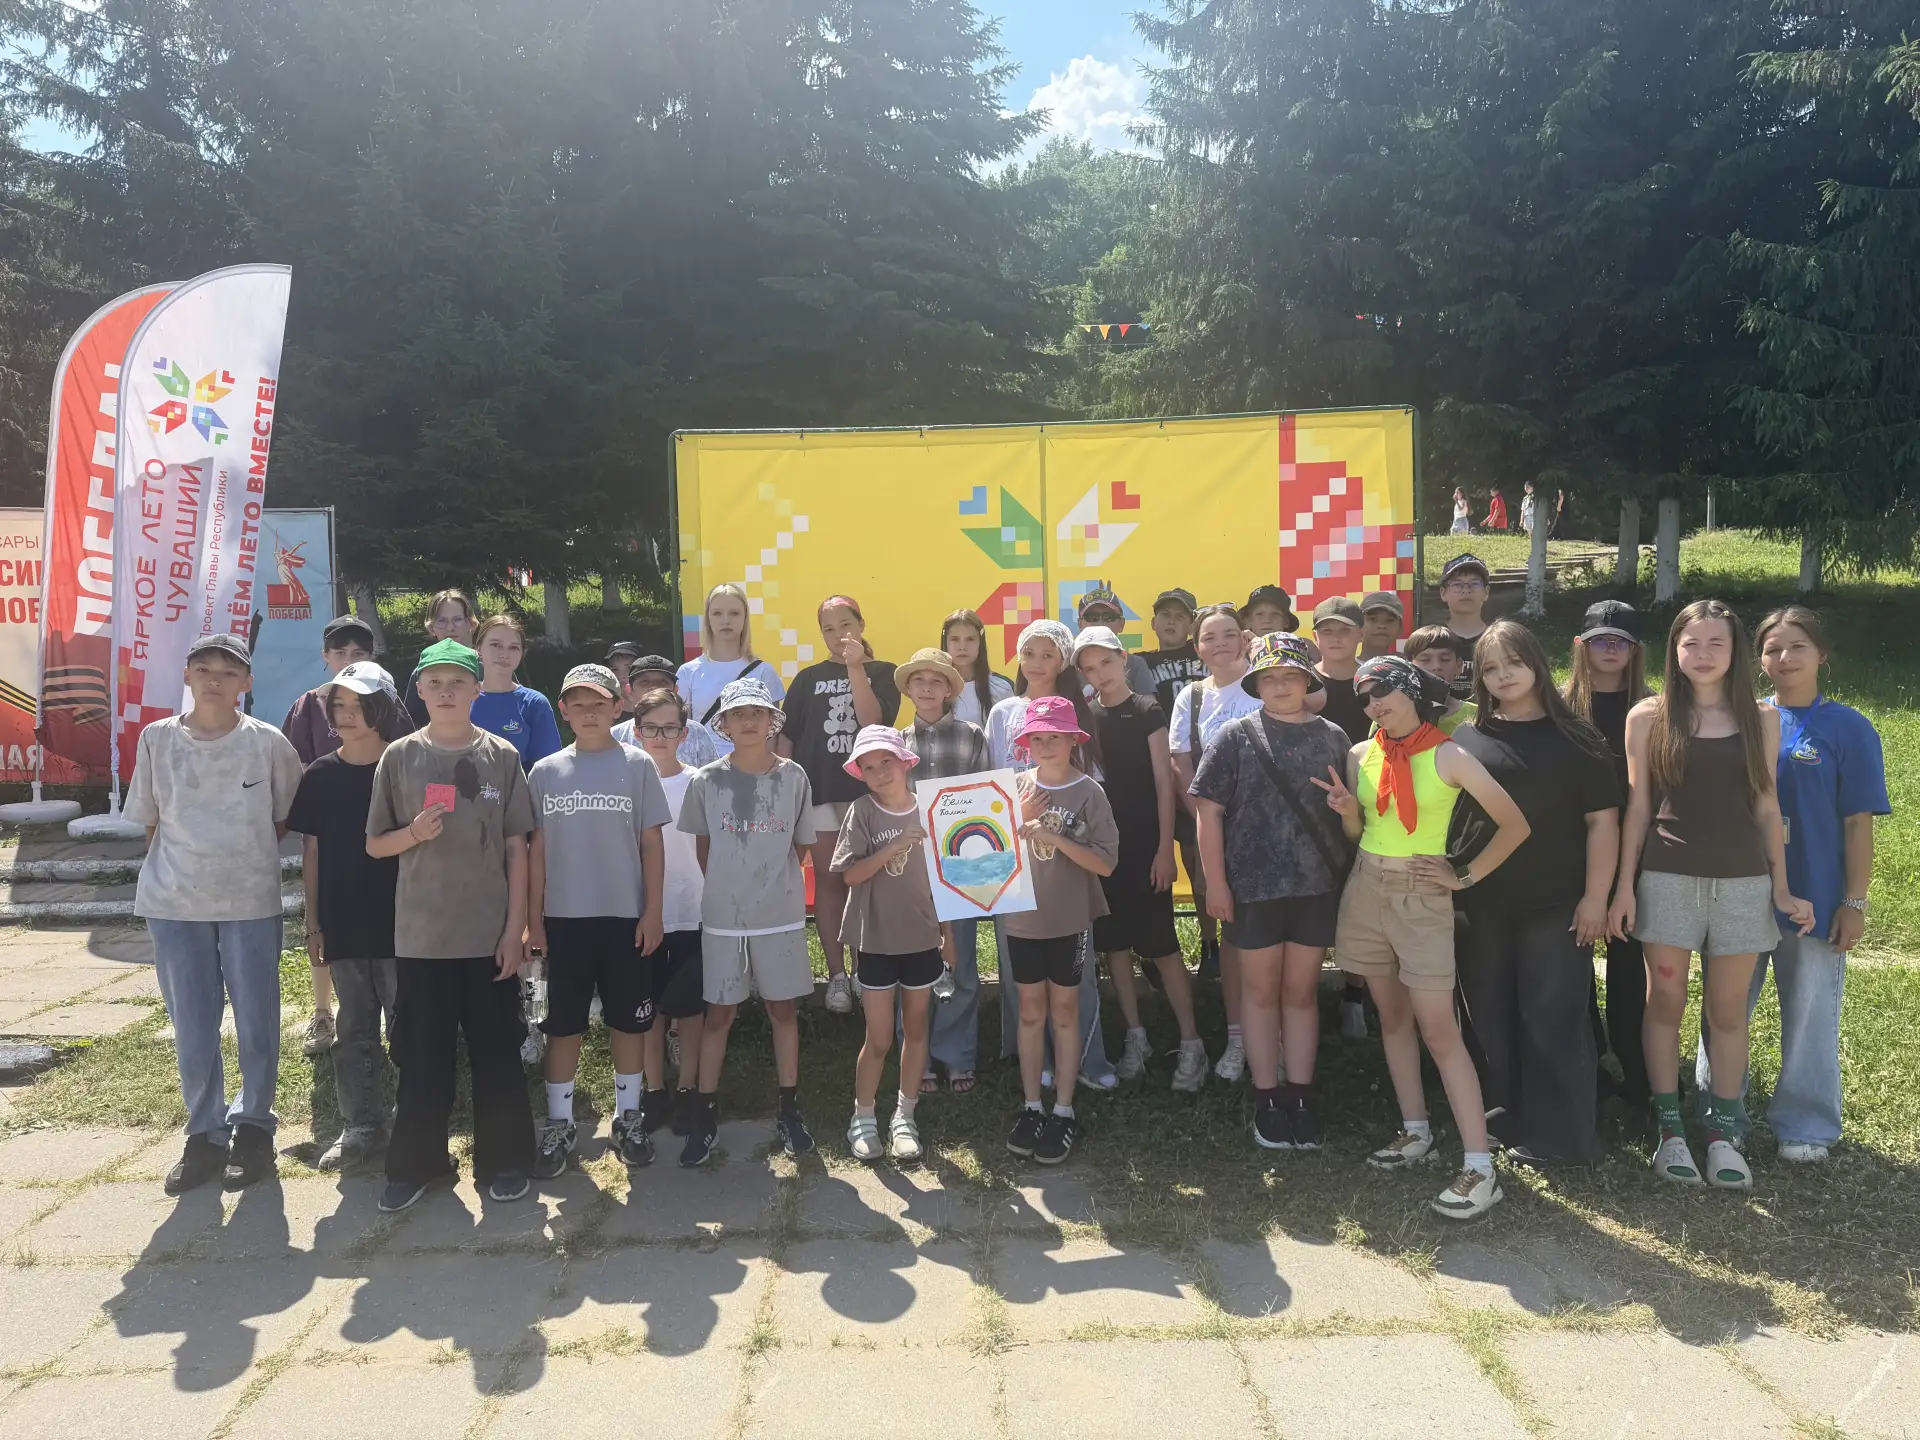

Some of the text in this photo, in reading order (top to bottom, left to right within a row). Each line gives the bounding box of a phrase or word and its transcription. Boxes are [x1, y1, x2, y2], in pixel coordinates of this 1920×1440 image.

[246, 376, 277, 494] ВМЕСТЕ!
[209, 470, 228, 550] Республики
[237, 502, 261, 572] ЛЕТО
[0, 536, 39, 548] АРЫ
[133, 458, 167, 660] ЯРКОЕ ЛЕТО
[164, 464, 203, 622] ЧУВАШИИ
[205, 554, 220, 592] Главы
[268, 608, 313, 621] ПОБЕДА!
[814, 678, 872, 695] DRE
[543, 789, 633, 815] beginmore
